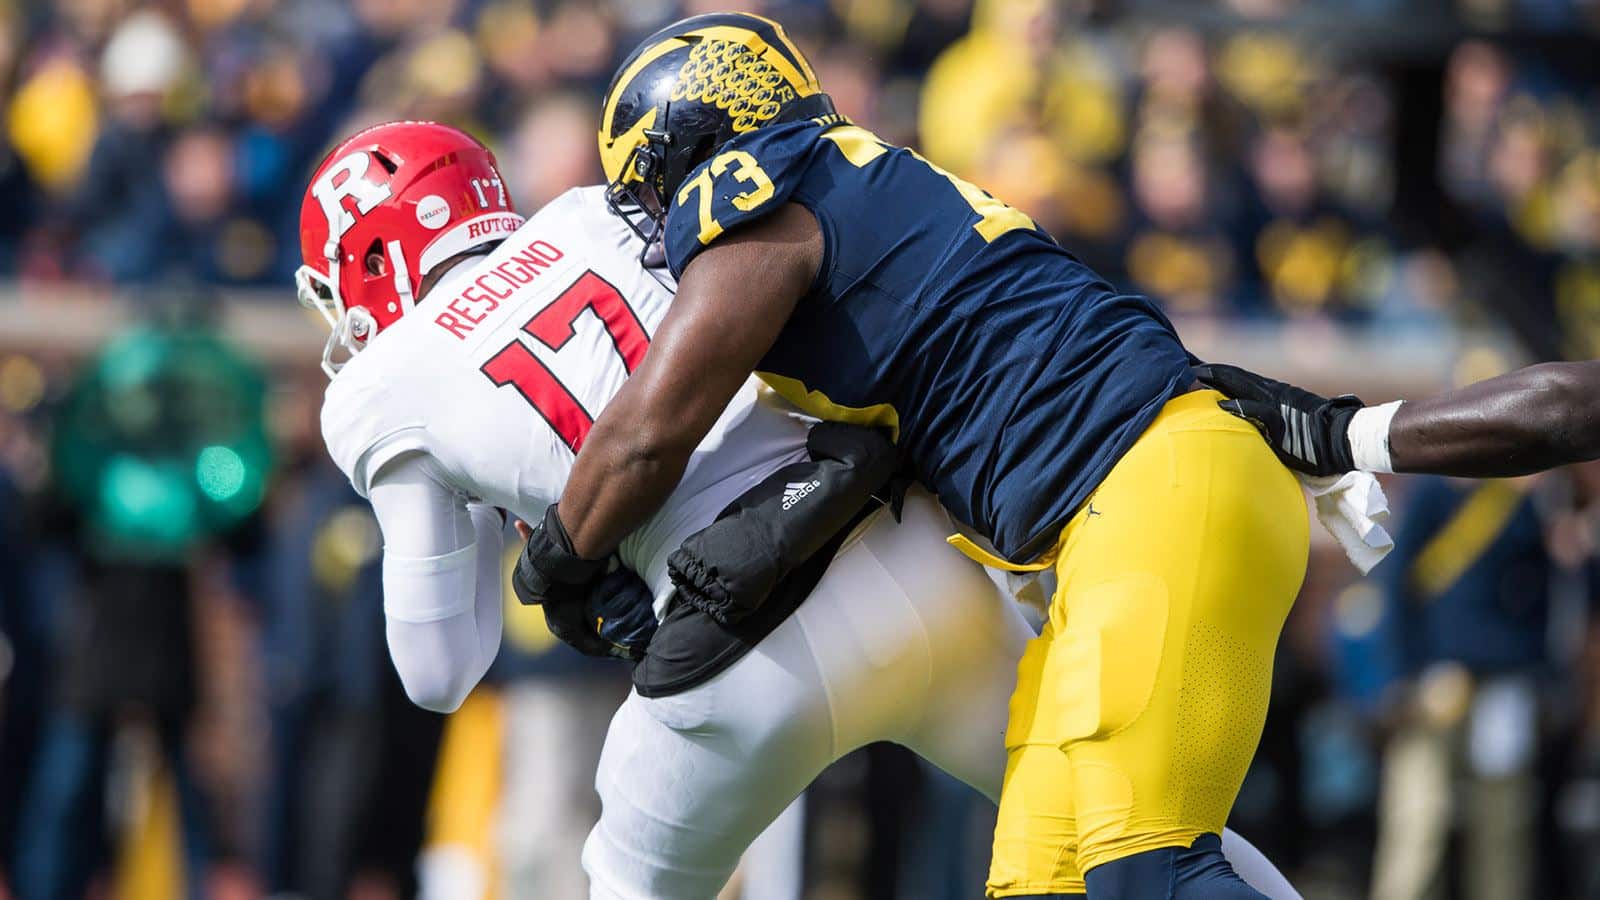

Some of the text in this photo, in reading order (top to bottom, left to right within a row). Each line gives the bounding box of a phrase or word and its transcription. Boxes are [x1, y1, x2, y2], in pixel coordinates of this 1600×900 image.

[774, 86, 795, 104] 73
[312, 151, 393, 239] R
[471, 178, 507, 209] 17
[678, 150, 775, 245] 73
[434, 239, 565, 341] RESCIGNO
[479, 268, 652, 456] 17
[782, 479, 821, 510] adidas
